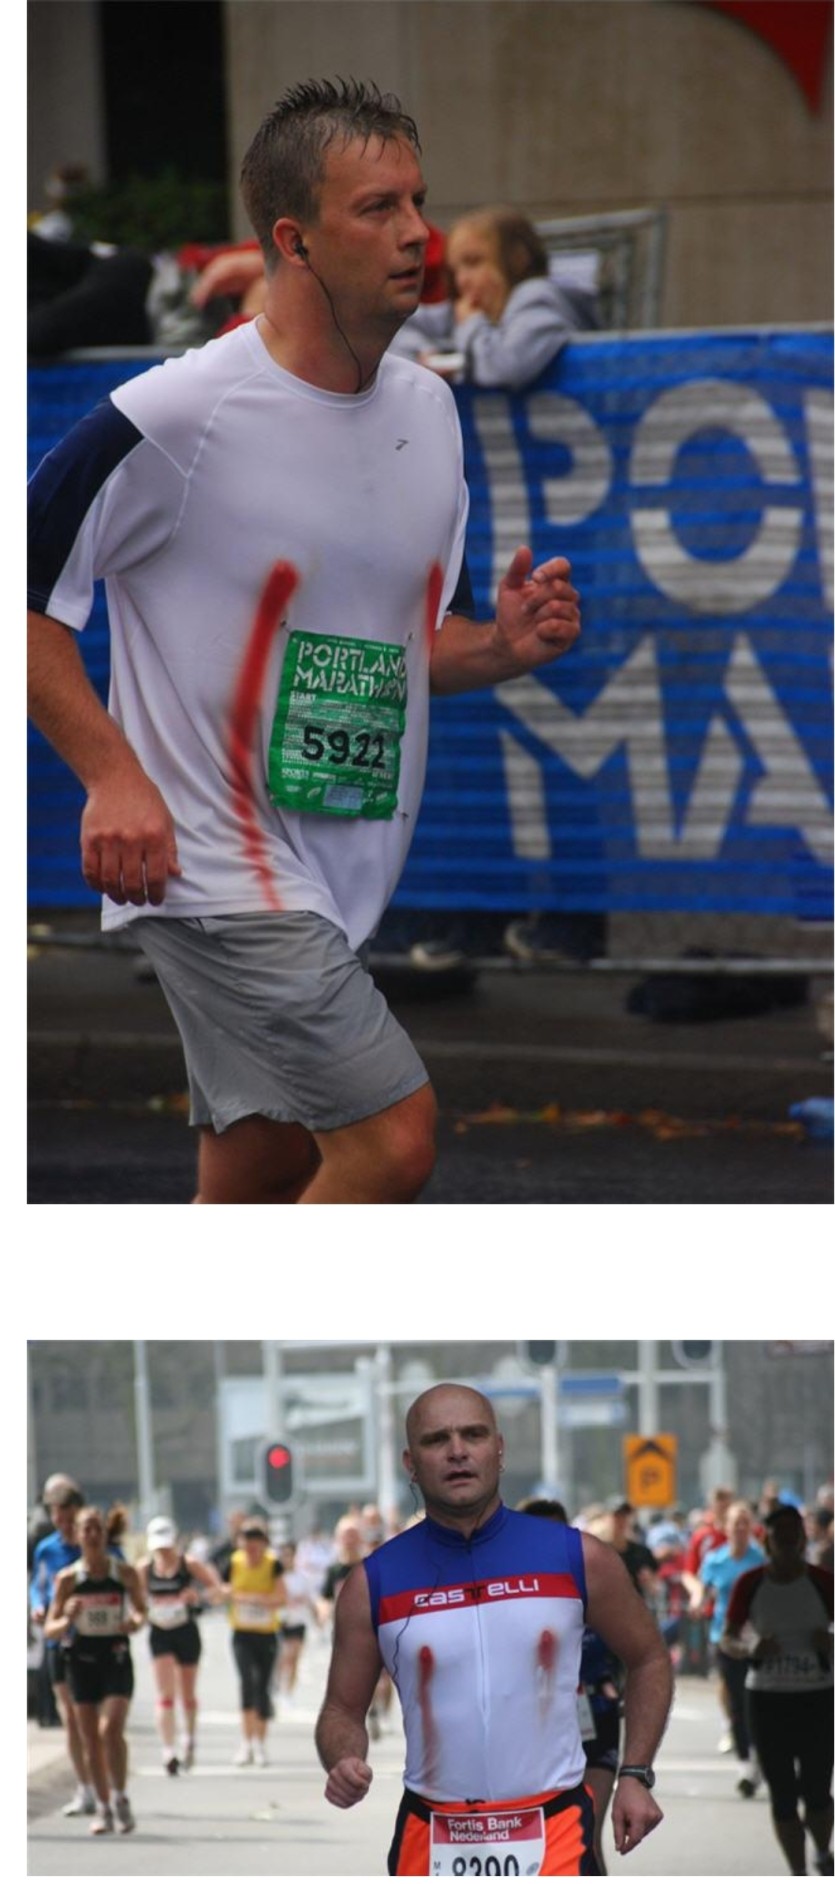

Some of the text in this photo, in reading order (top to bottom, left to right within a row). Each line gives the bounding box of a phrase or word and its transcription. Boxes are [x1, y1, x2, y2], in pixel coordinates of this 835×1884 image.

[475, 380, 834, 615] PO
[298, 641, 405, 677] PORTLAND
[294, 665, 406, 700] MARATHON
[302, 726, 386, 769] 5922
[494, 634, 834, 865] MA
[447, 1816, 522, 1832] Fortis Bank
[450, 1830, 510, 1842] Nederland
